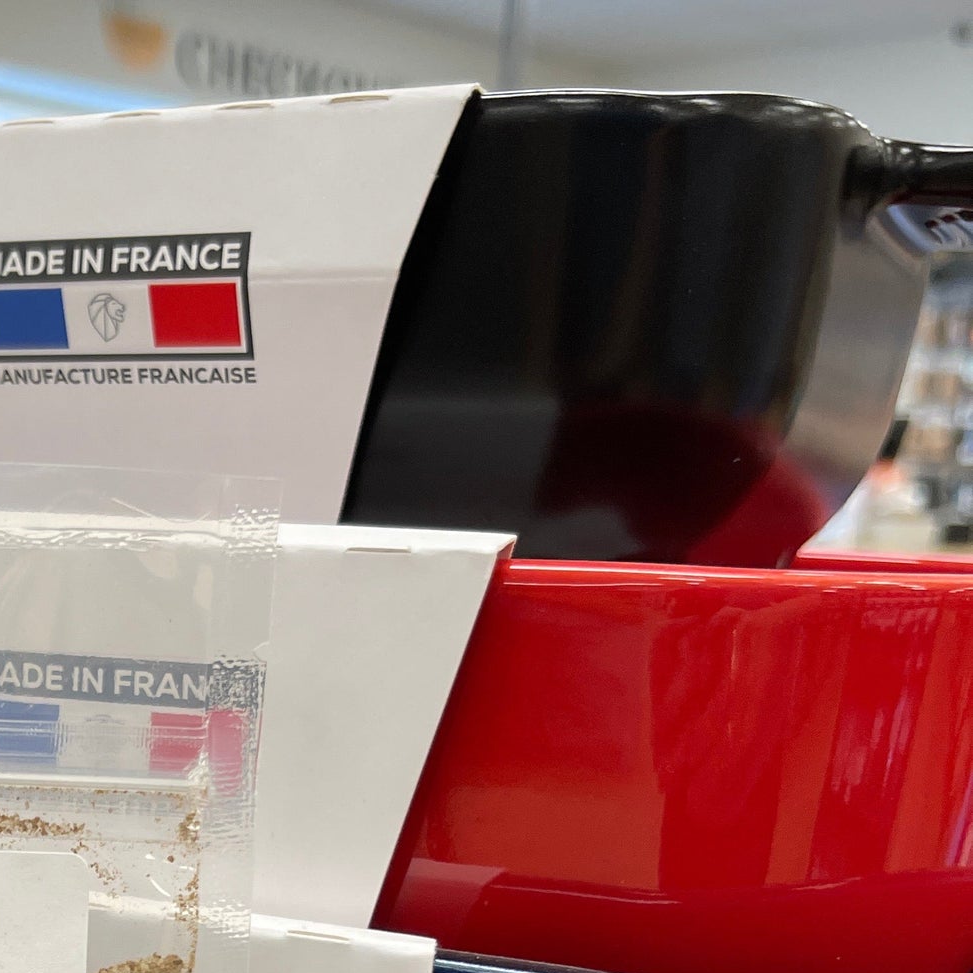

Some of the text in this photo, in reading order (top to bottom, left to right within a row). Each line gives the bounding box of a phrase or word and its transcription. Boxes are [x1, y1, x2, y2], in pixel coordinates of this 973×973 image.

[71, 245, 102, 274] IN
[110, 242, 242, 272] FRANCE
[138, 366, 257, 384] FRANCAISE
[72, 666, 104, 694] IN
[113, 669, 225, 702] FRAN
